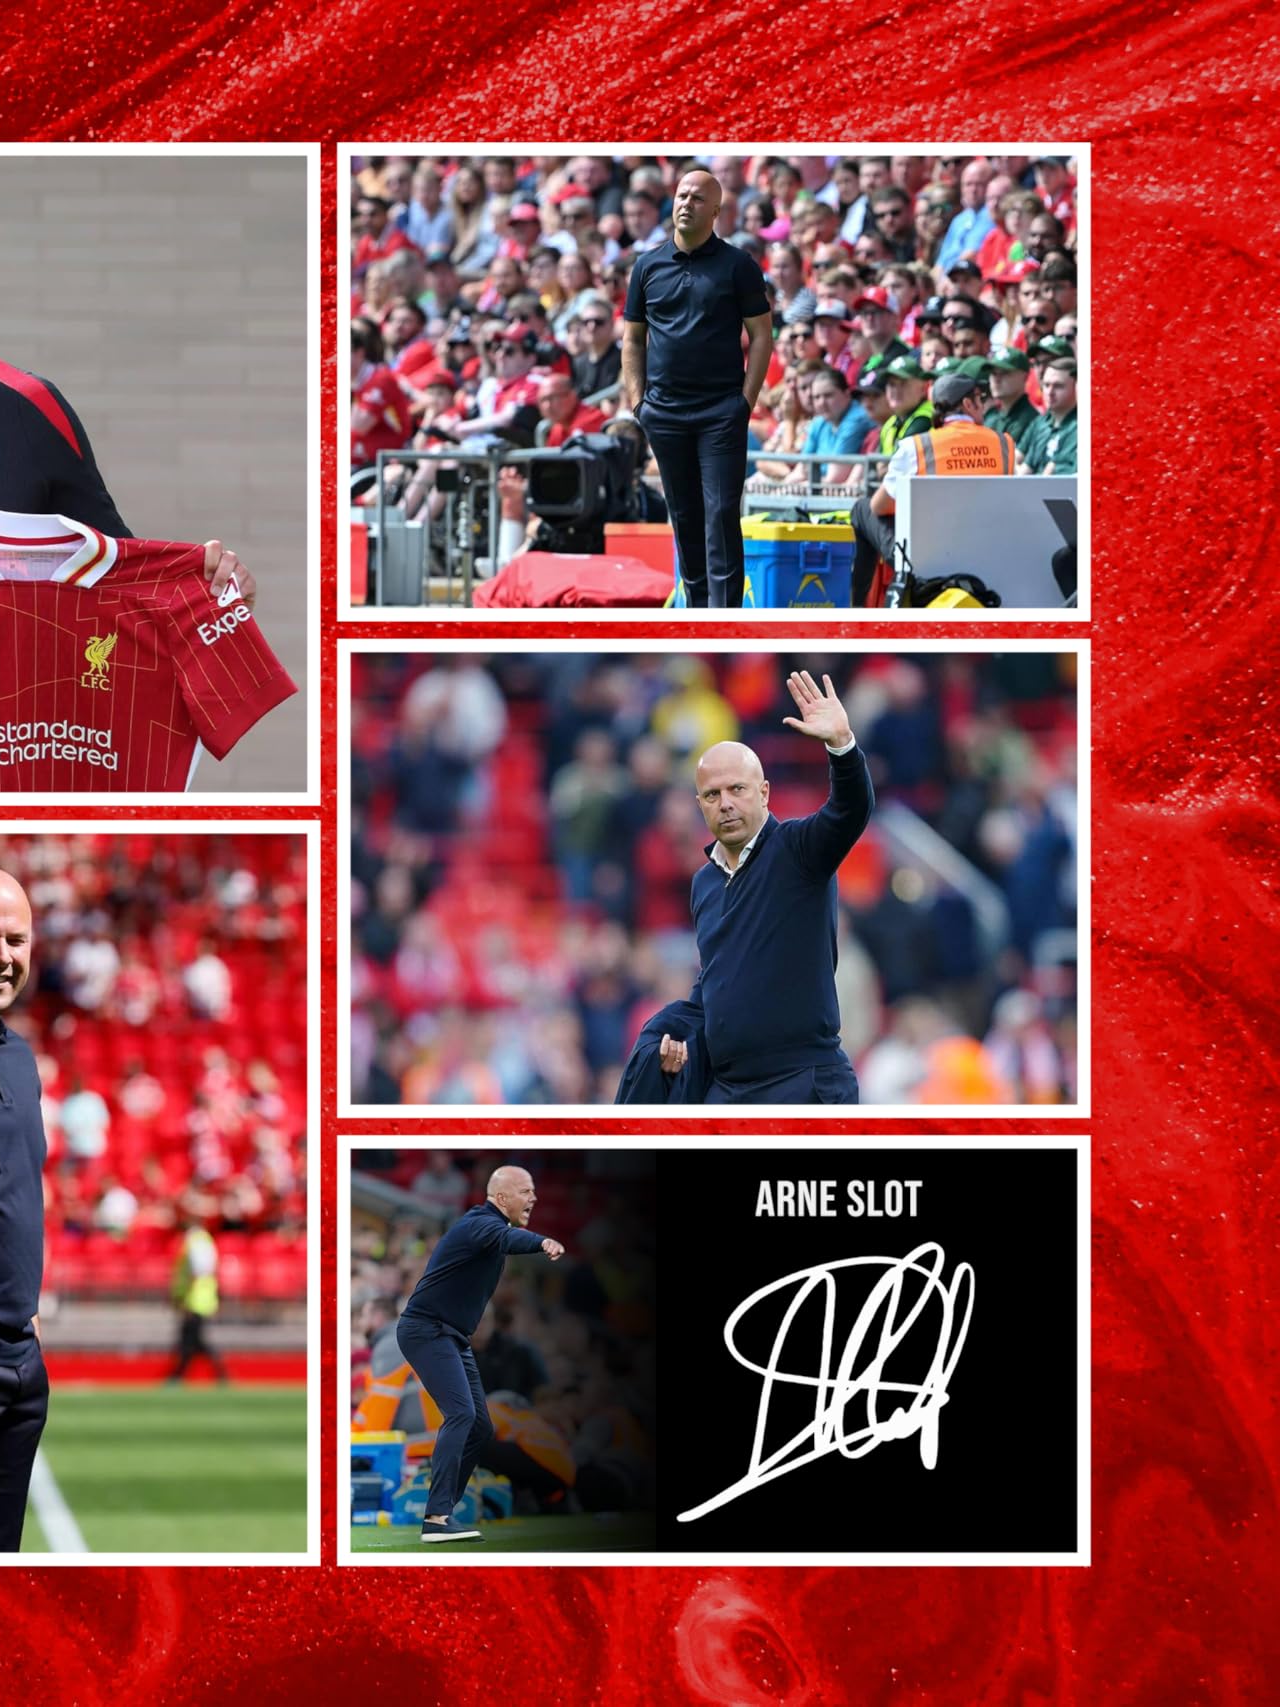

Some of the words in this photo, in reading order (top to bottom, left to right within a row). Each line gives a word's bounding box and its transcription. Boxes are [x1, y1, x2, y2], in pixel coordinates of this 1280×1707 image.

[950, 446, 989, 457] CROWD
[946, 458, 997, 470] STEWARD
[197, 605, 251, 646] Expe
